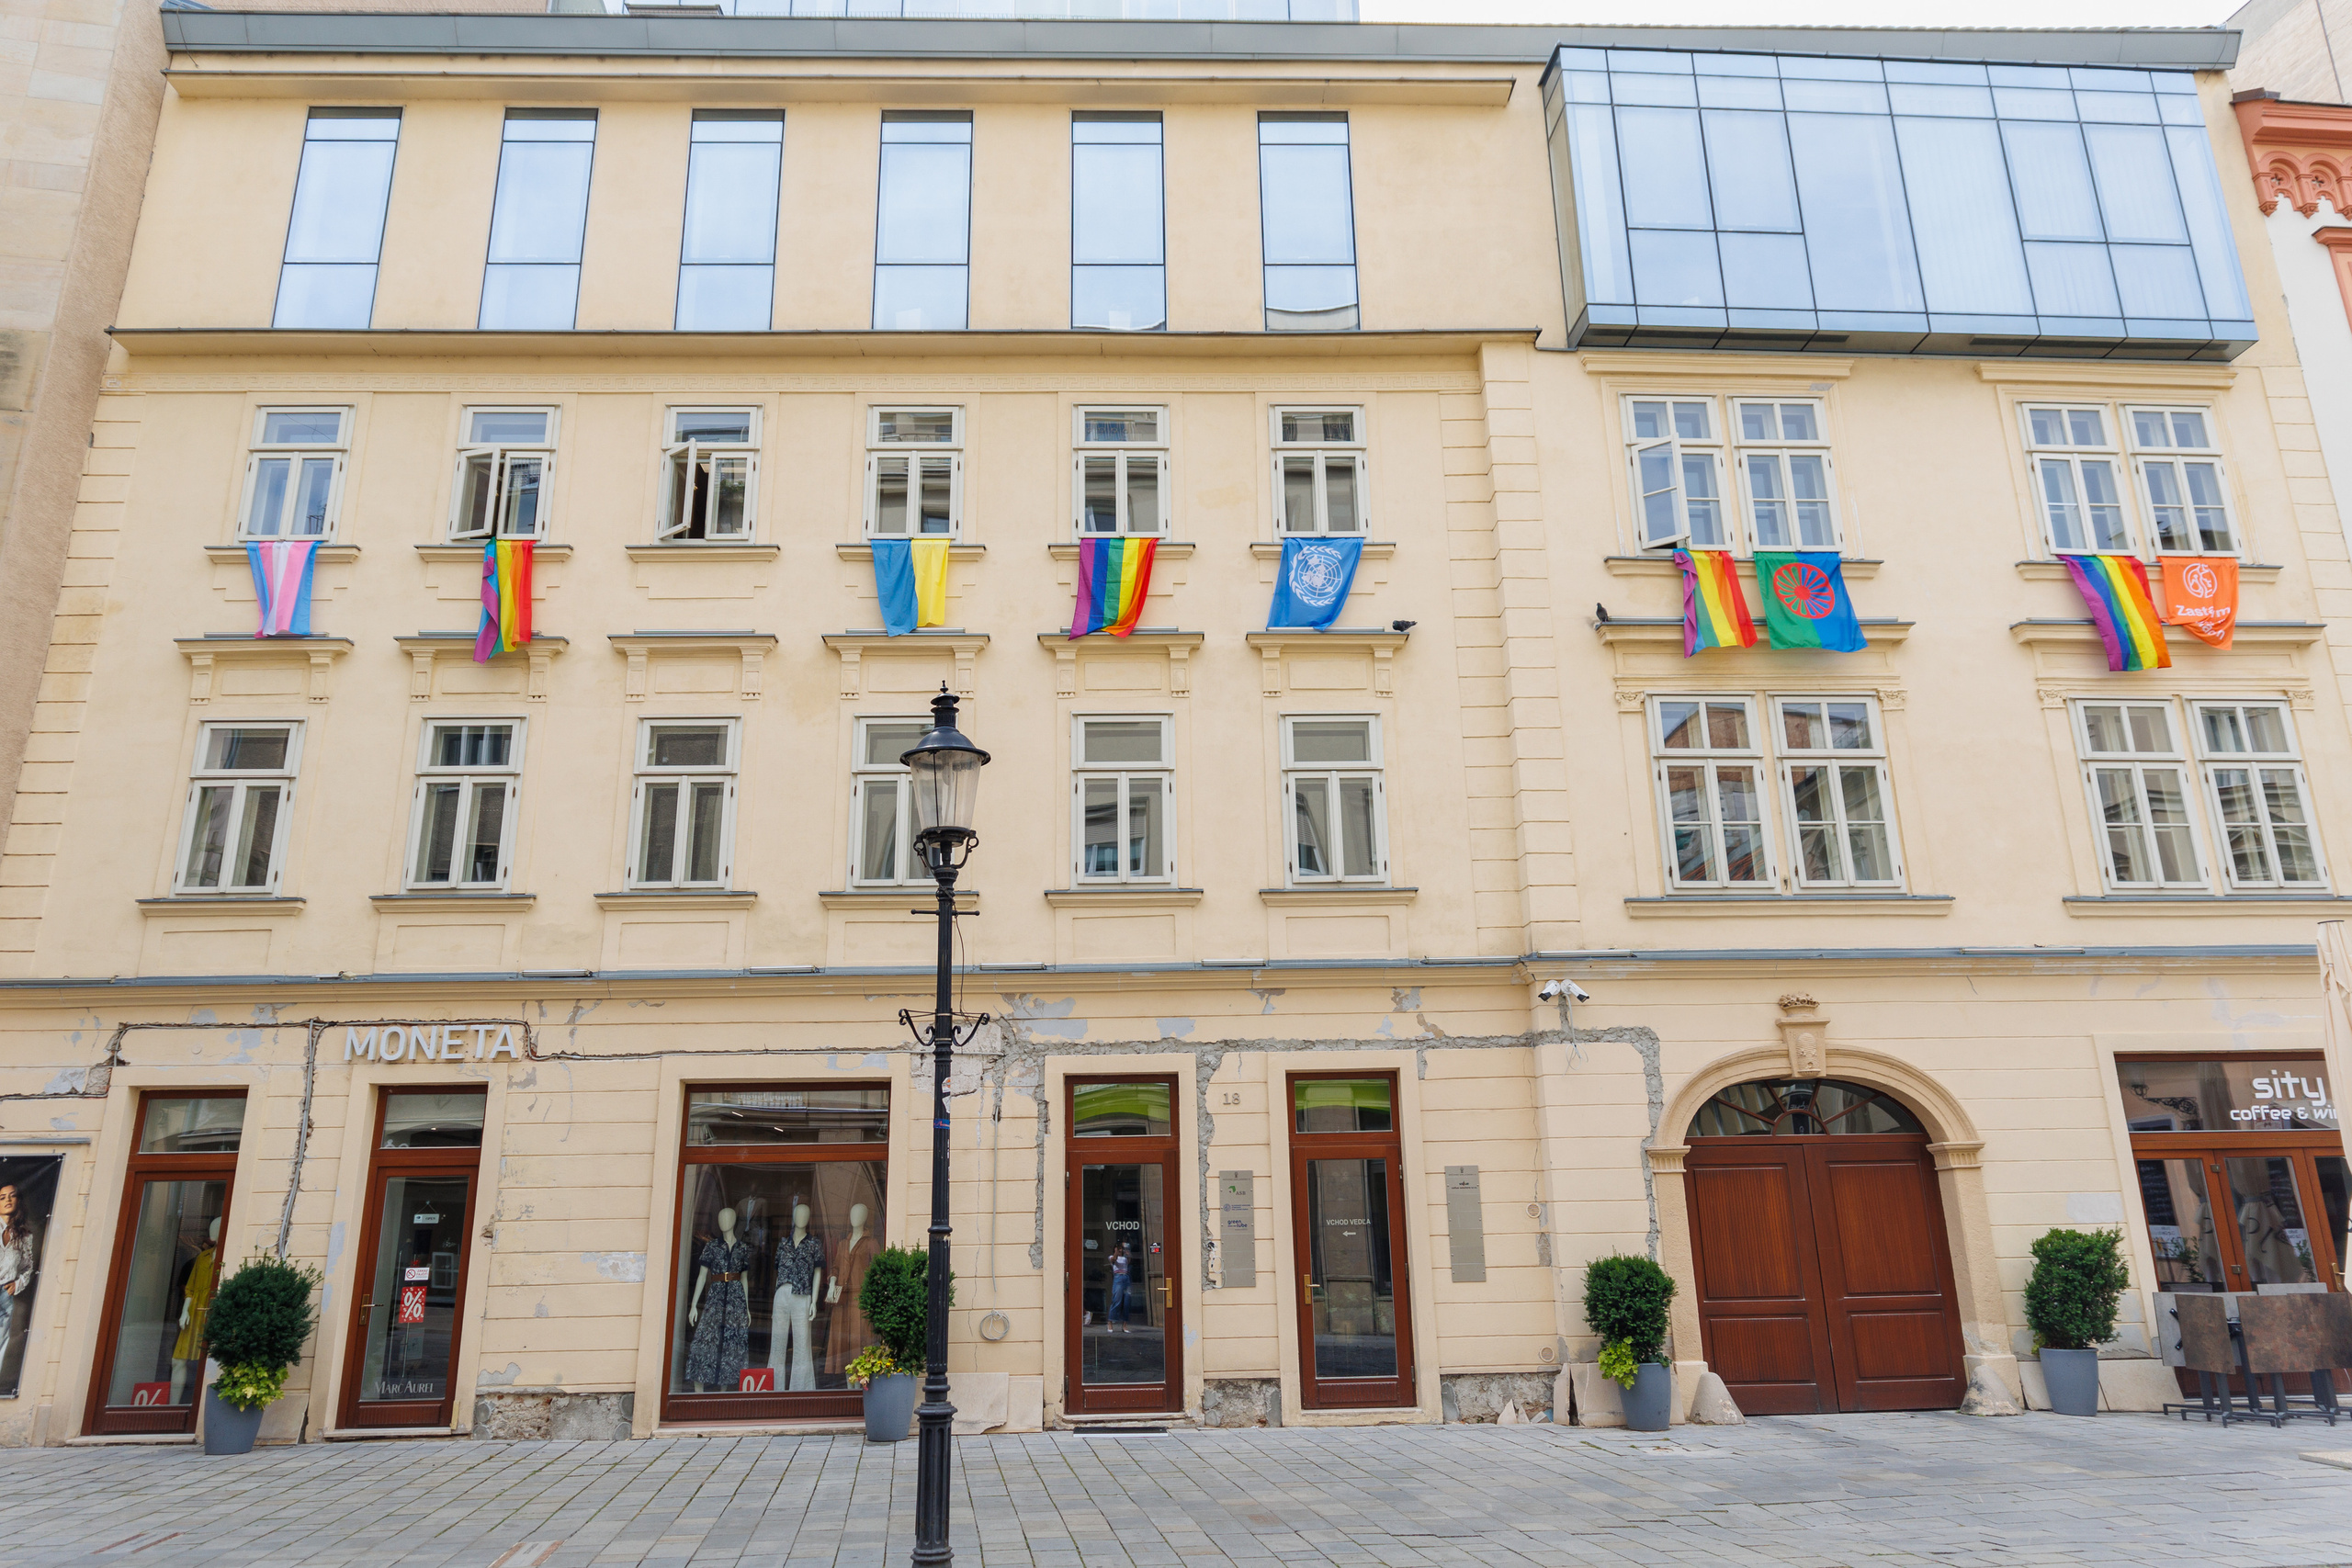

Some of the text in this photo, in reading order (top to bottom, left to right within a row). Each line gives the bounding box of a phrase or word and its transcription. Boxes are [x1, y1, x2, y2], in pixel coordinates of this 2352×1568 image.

[344, 1025, 520, 1061] MONETA
[1223, 1092, 1241, 1105] 18
[2252, 1069, 2326, 1107] sity
[2230, 1105, 2292, 1121] coffee
[2297, 1107, 2309, 1120] &
[1105, 1221, 1140, 1231] VCHOD
[403, 1291, 423, 1318] %
